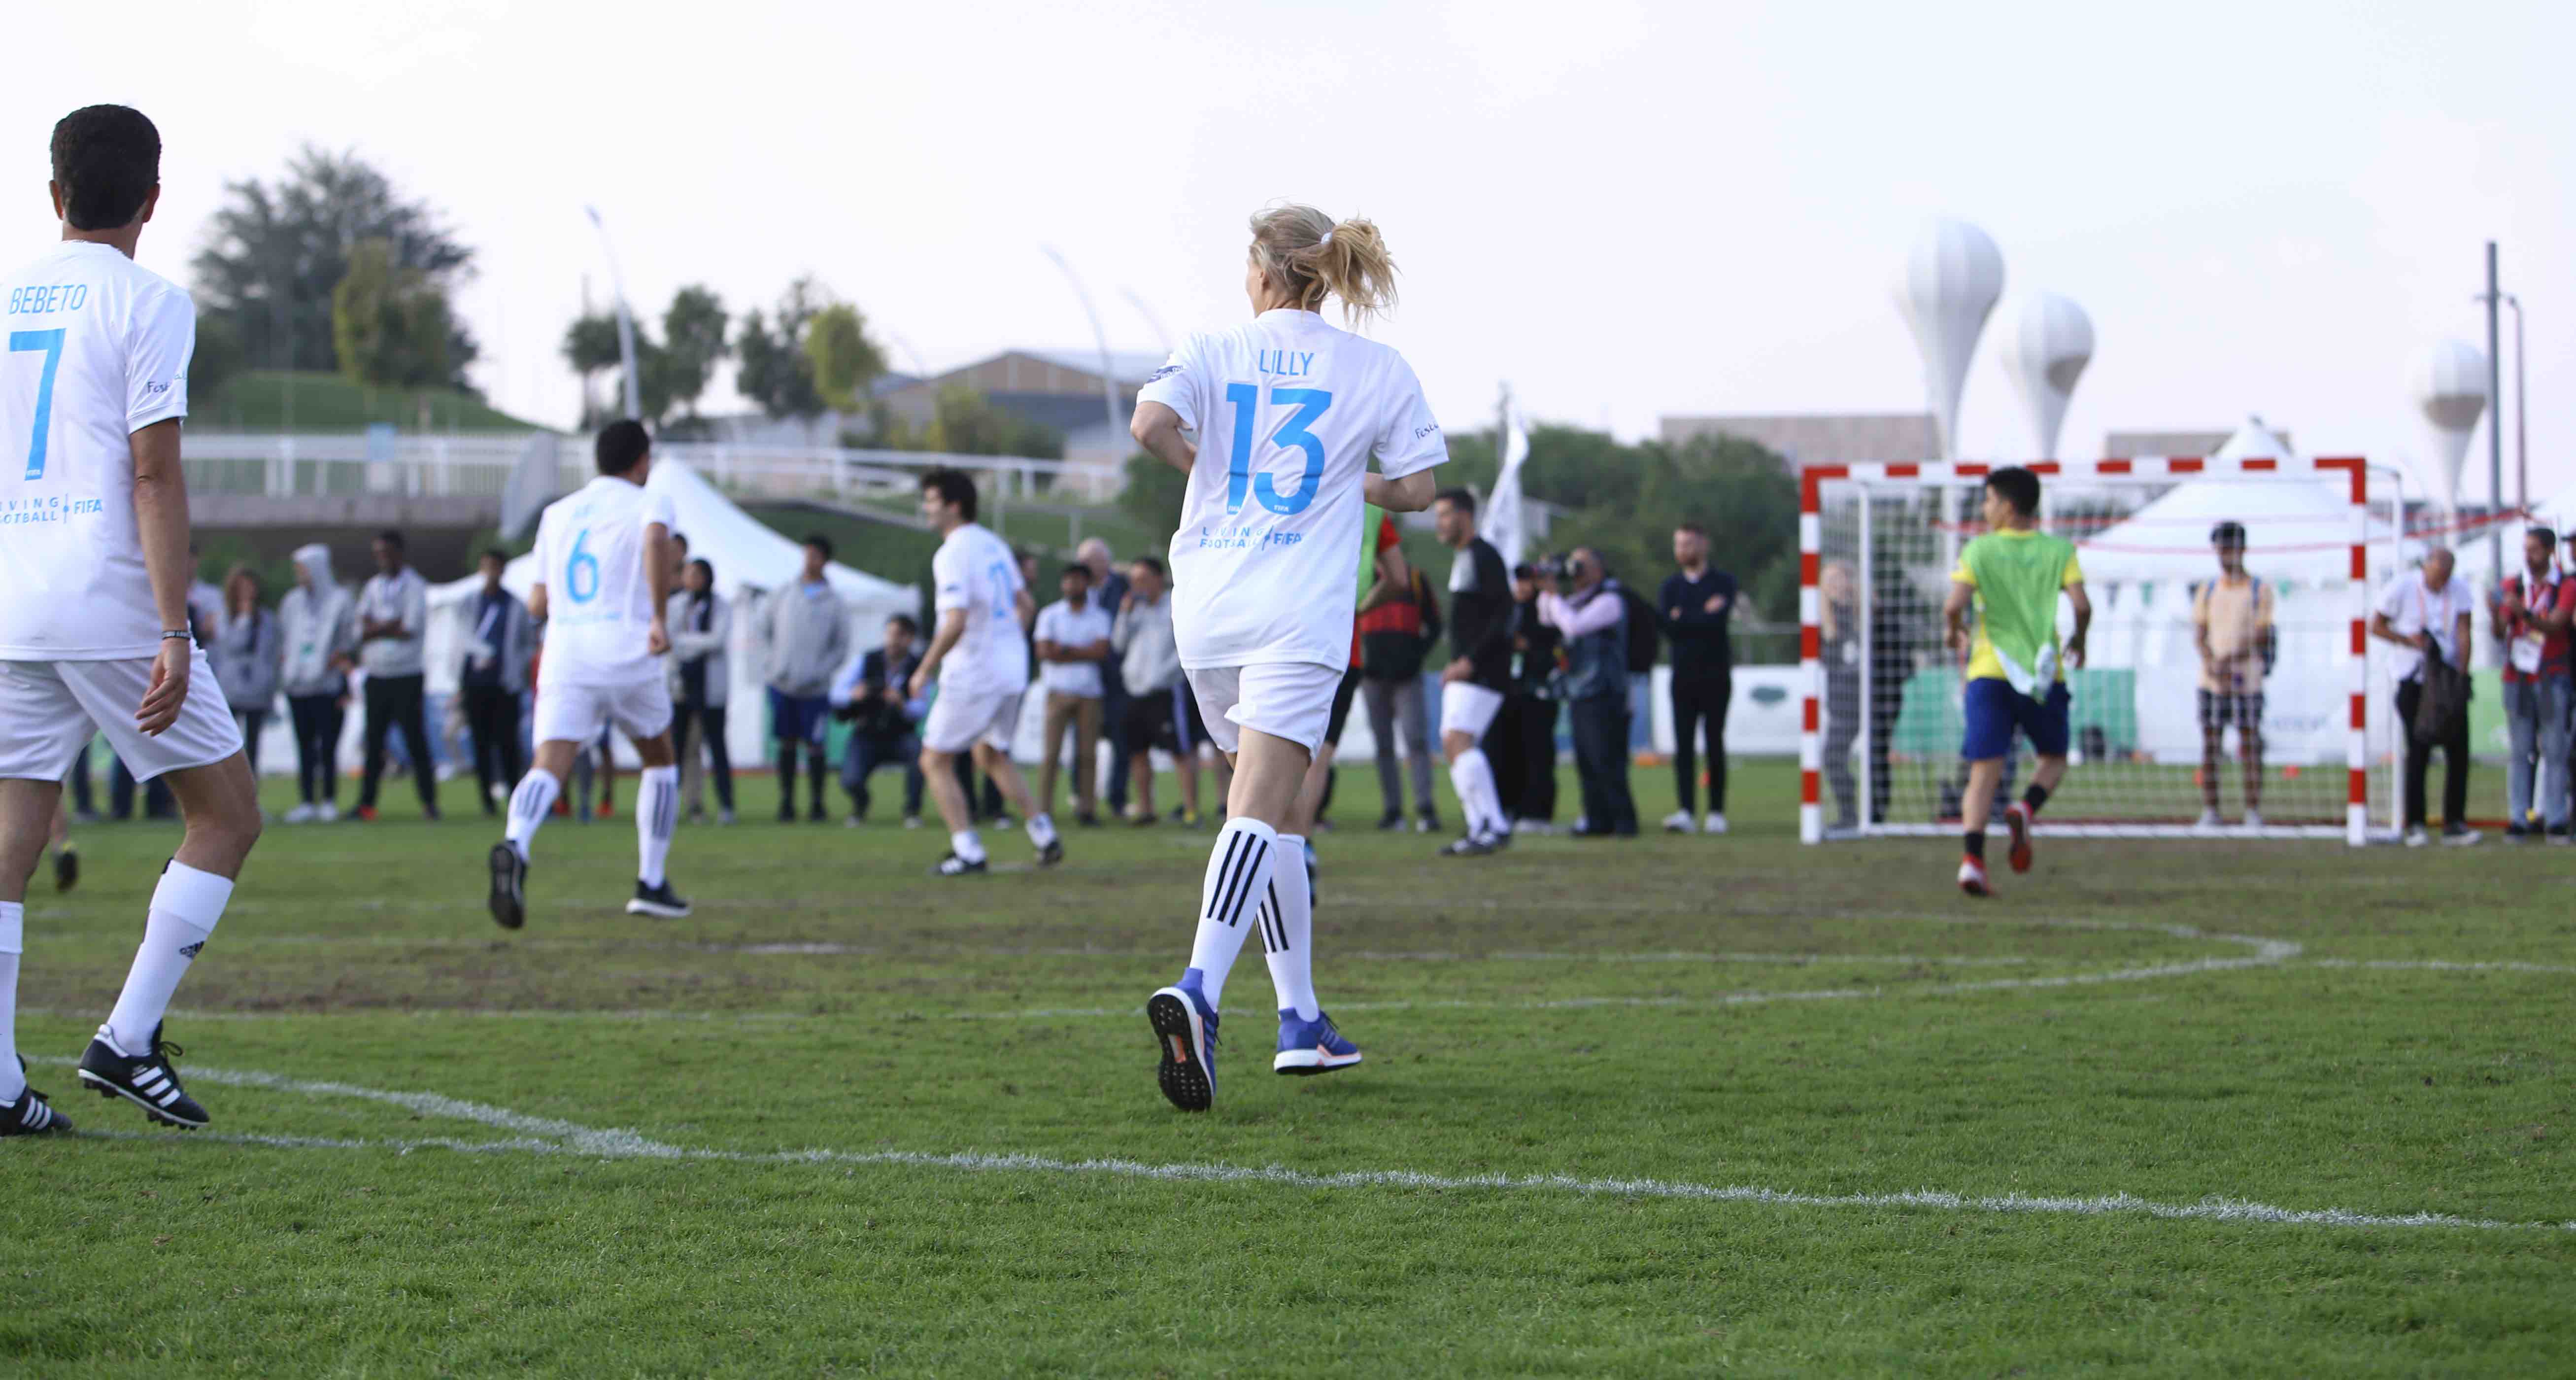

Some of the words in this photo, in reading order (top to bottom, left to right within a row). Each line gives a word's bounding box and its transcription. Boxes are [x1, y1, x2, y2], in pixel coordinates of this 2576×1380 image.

[8, 284, 87, 314] BEBETO
[1259, 349, 1314, 376] LILLY
[9, 328, 67, 481] 7
[1226, 382, 1332, 515] 13
[0, 511, 58, 524] OTBALL
[74, 499, 103, 514] FIFA
[1274, 532, 1301, 545] FIFA
[566, 527, 599, 605] 6
